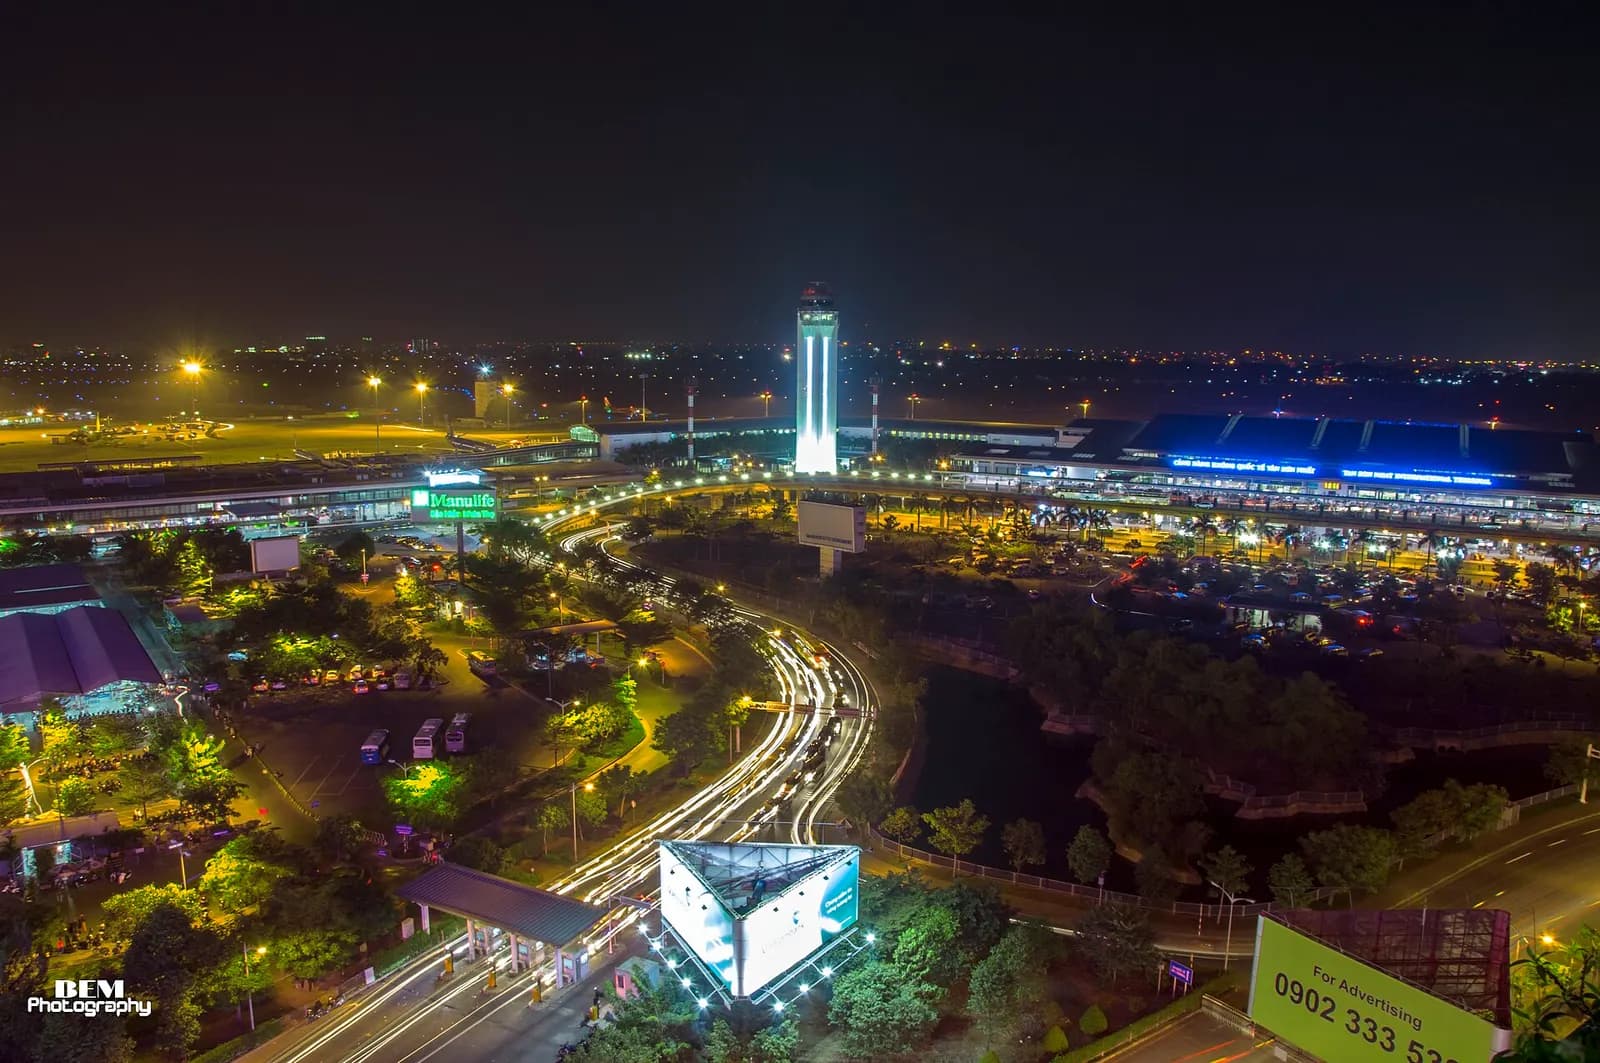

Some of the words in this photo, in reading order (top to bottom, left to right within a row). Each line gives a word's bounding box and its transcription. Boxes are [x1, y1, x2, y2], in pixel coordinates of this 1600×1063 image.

[430, 493, 495, 508] Manulife
[1275, 972, 1336, 1023] 0902
[1344, 1009, 1396, 1053] 333
[1406, 1040, 1459, 1063] 53
[1312, 965, 1336, 986] For
[1339, 978, 1422, 1031] Advertising
